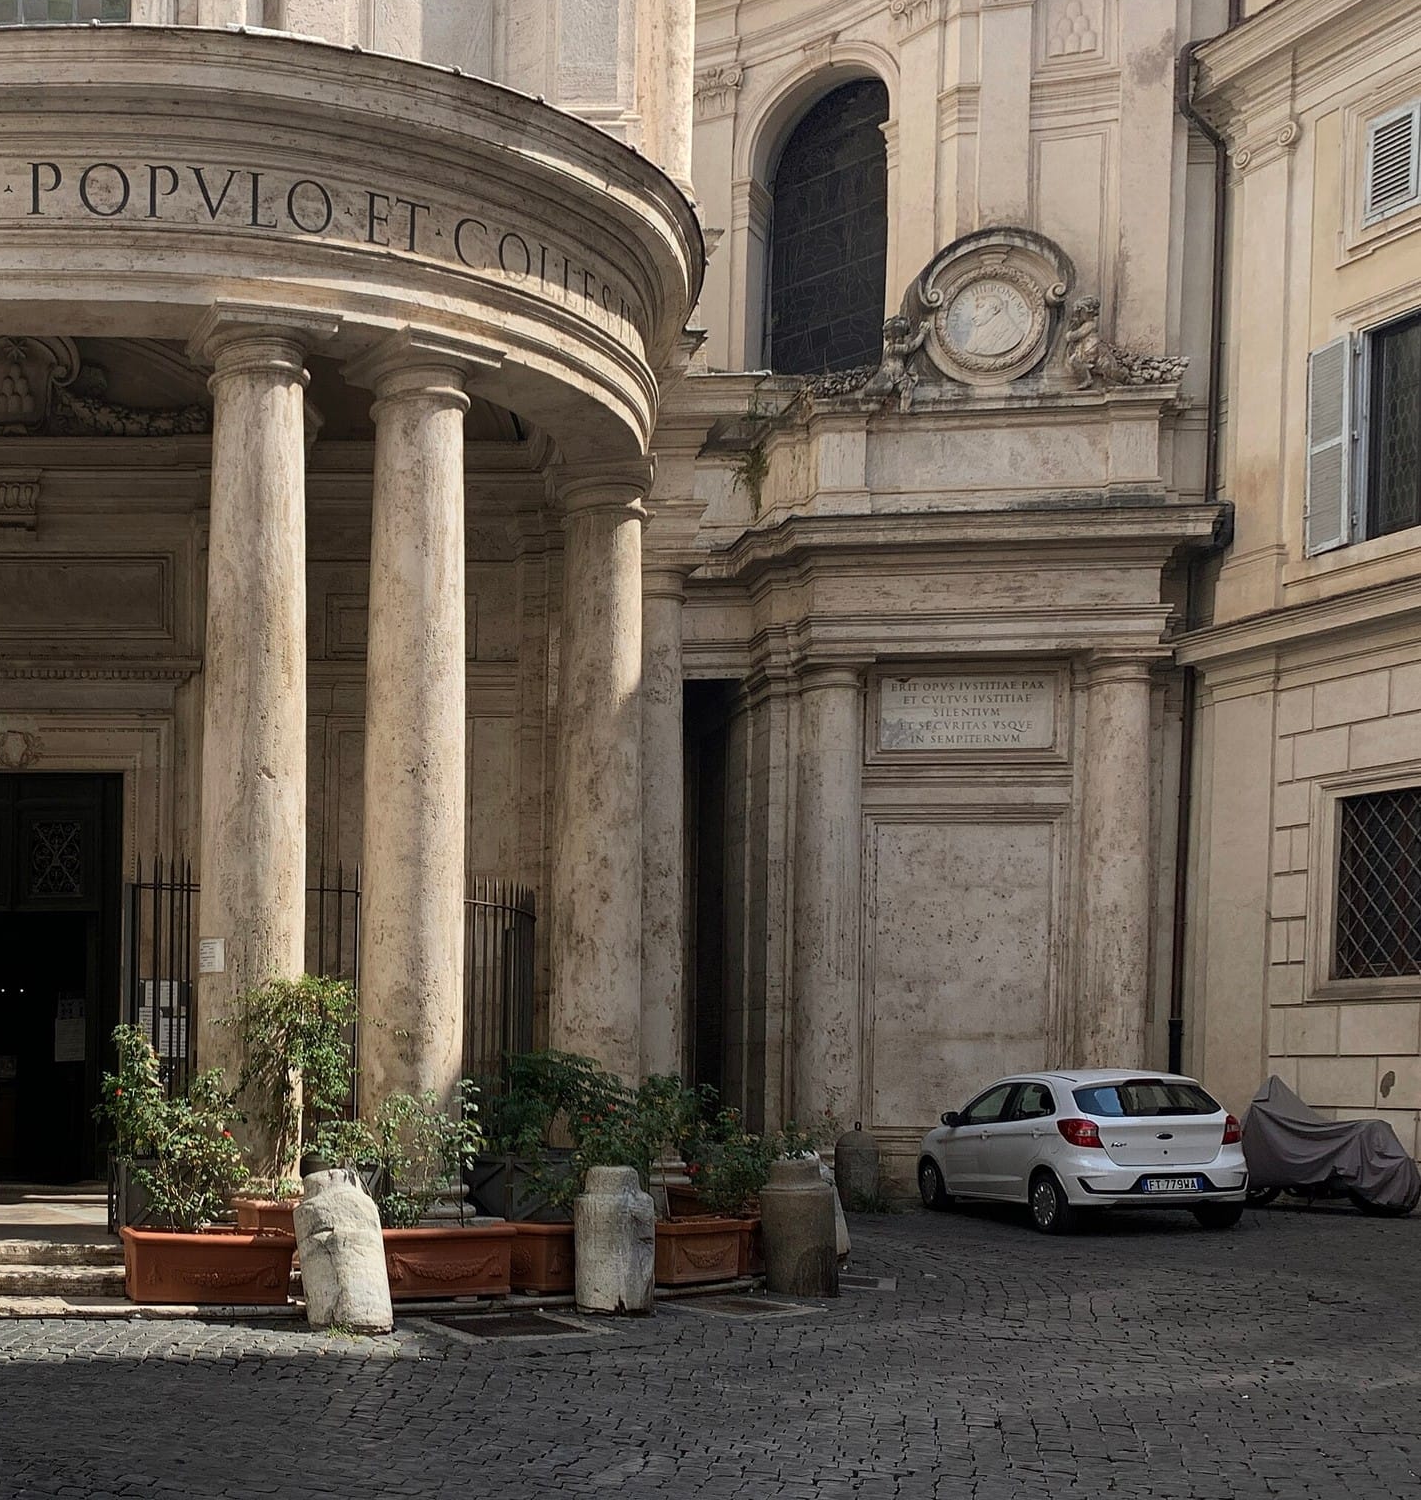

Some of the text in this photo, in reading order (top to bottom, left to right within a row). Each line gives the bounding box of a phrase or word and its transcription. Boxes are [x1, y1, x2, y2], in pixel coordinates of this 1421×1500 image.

[28, 162, 334, 234] POPVLO
[364, 191, 431, 255] ET
[890, 680, 1045, 693] ERIT OPVS IVSTITIAE PAX
[902, 693, 1032, 705] ET CVLTVS IVSTITIAE
[932, 707, 1001, 718] SILENTIVM
[900, 720, 1033, 732] ET SECVRITAS VSQVE
[910, 733, 1021, 744] IN SEMPITERNVM
